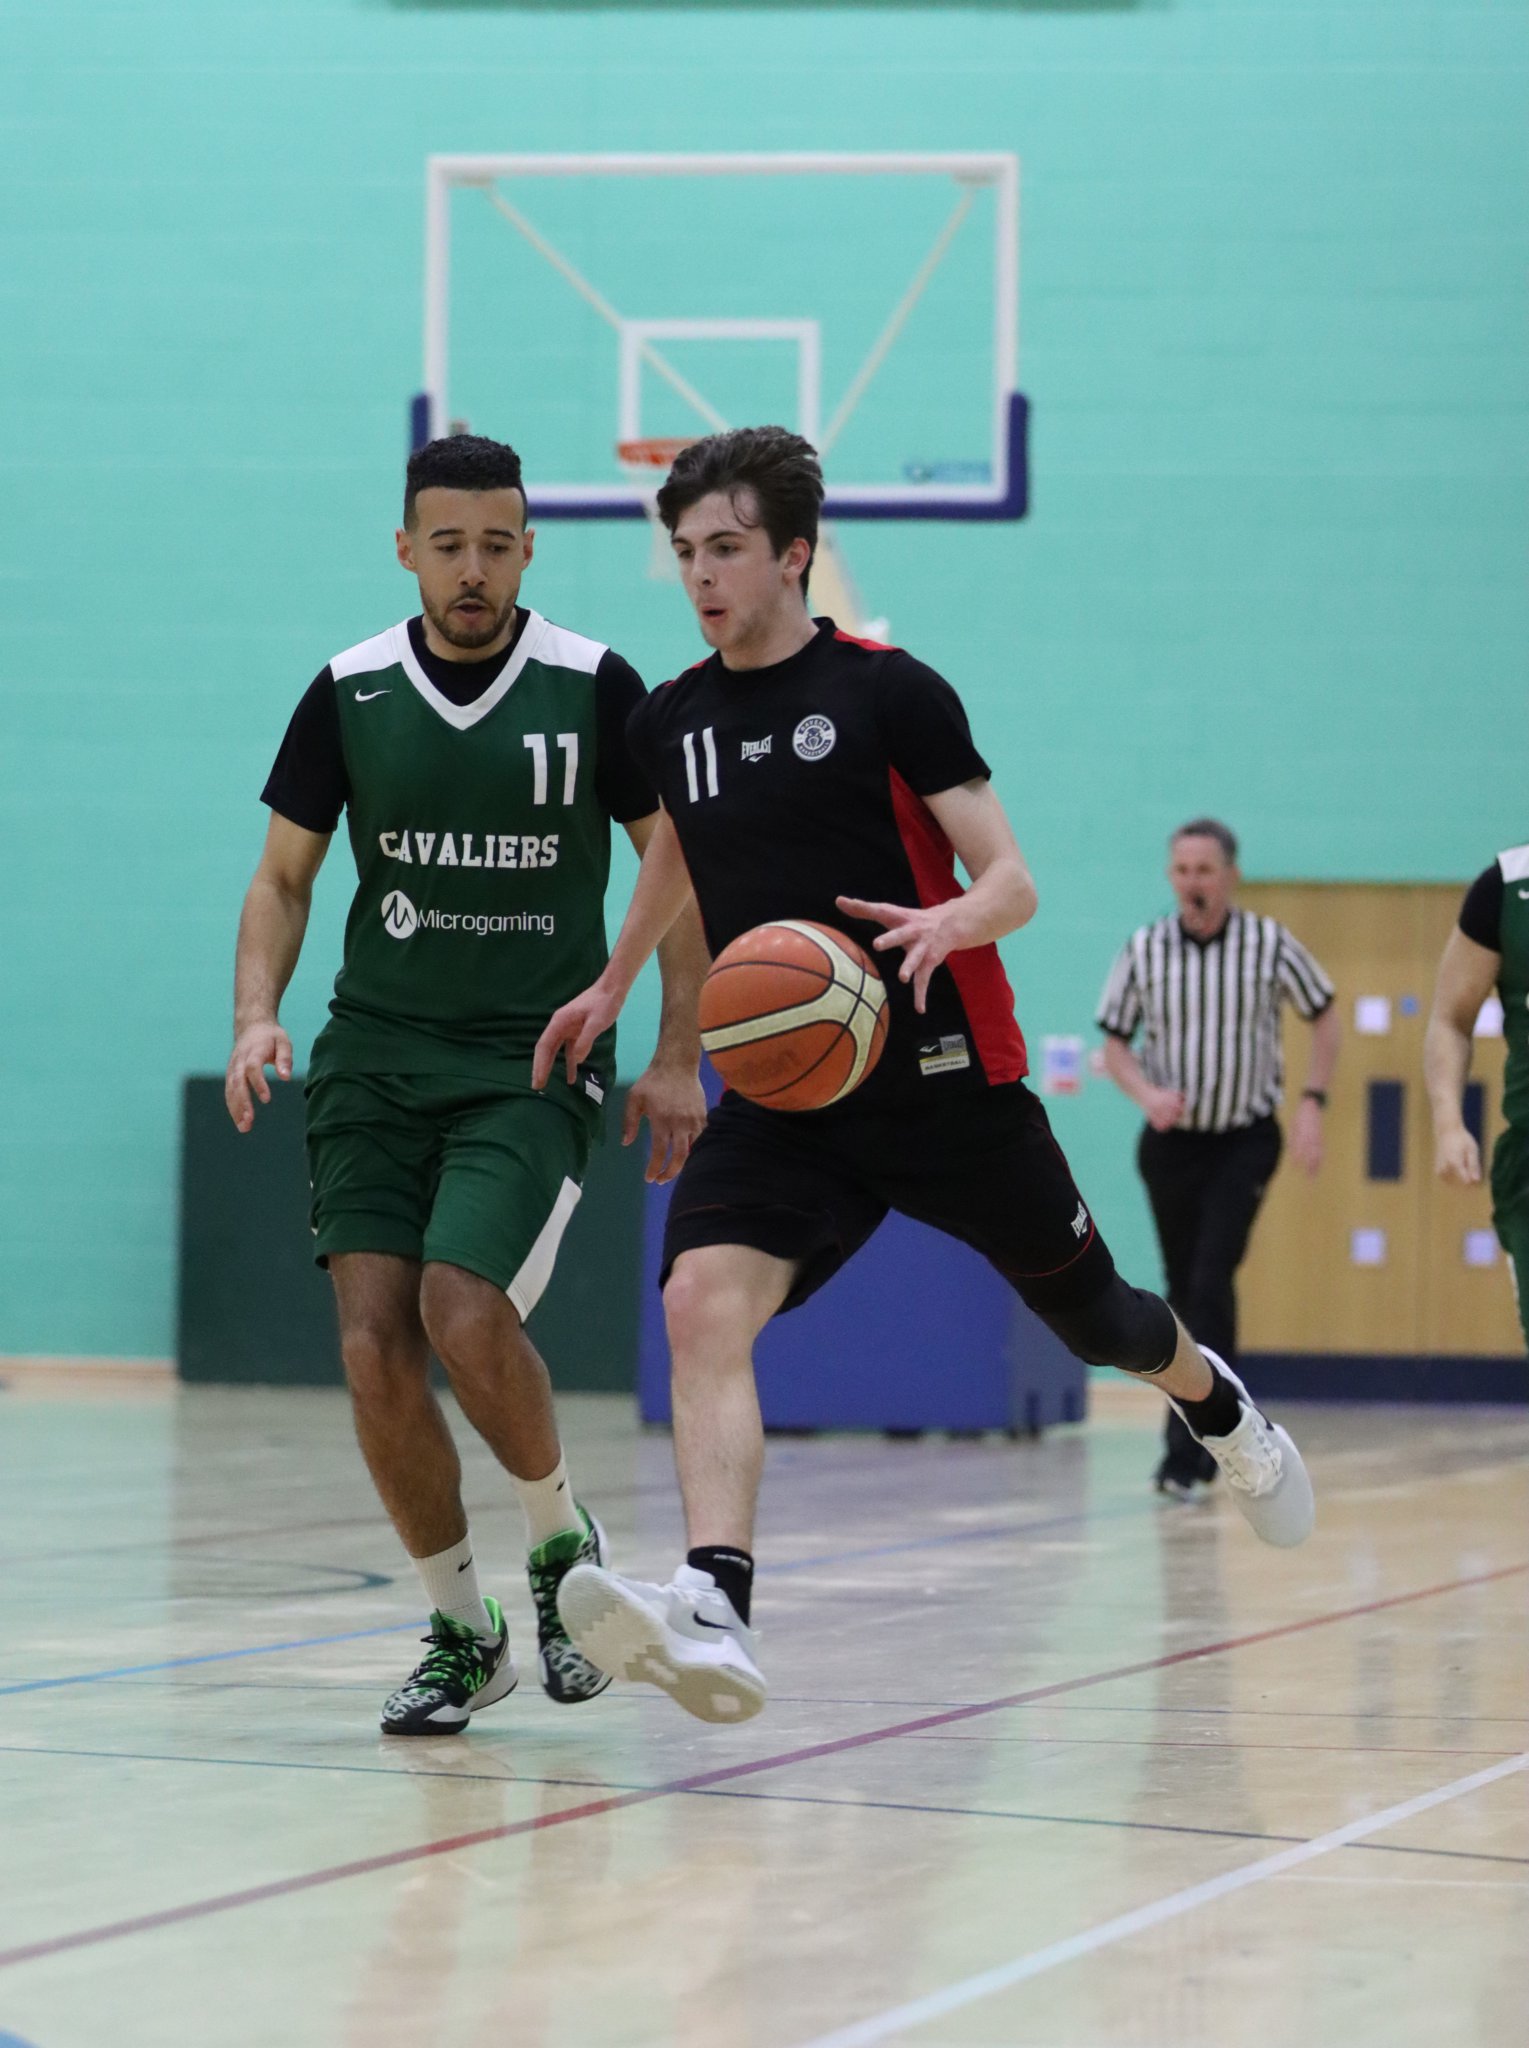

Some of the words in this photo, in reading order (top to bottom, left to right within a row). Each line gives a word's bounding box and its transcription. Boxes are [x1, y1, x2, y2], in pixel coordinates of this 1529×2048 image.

[683, 726, 719, 803] 11
[741, 734, 772, 760] EVERLAST
[523, 733, 579, 806] 11
[379, 829, 560, 869] CAVALIERS
[417, 909, 555, 936] Microgaming
